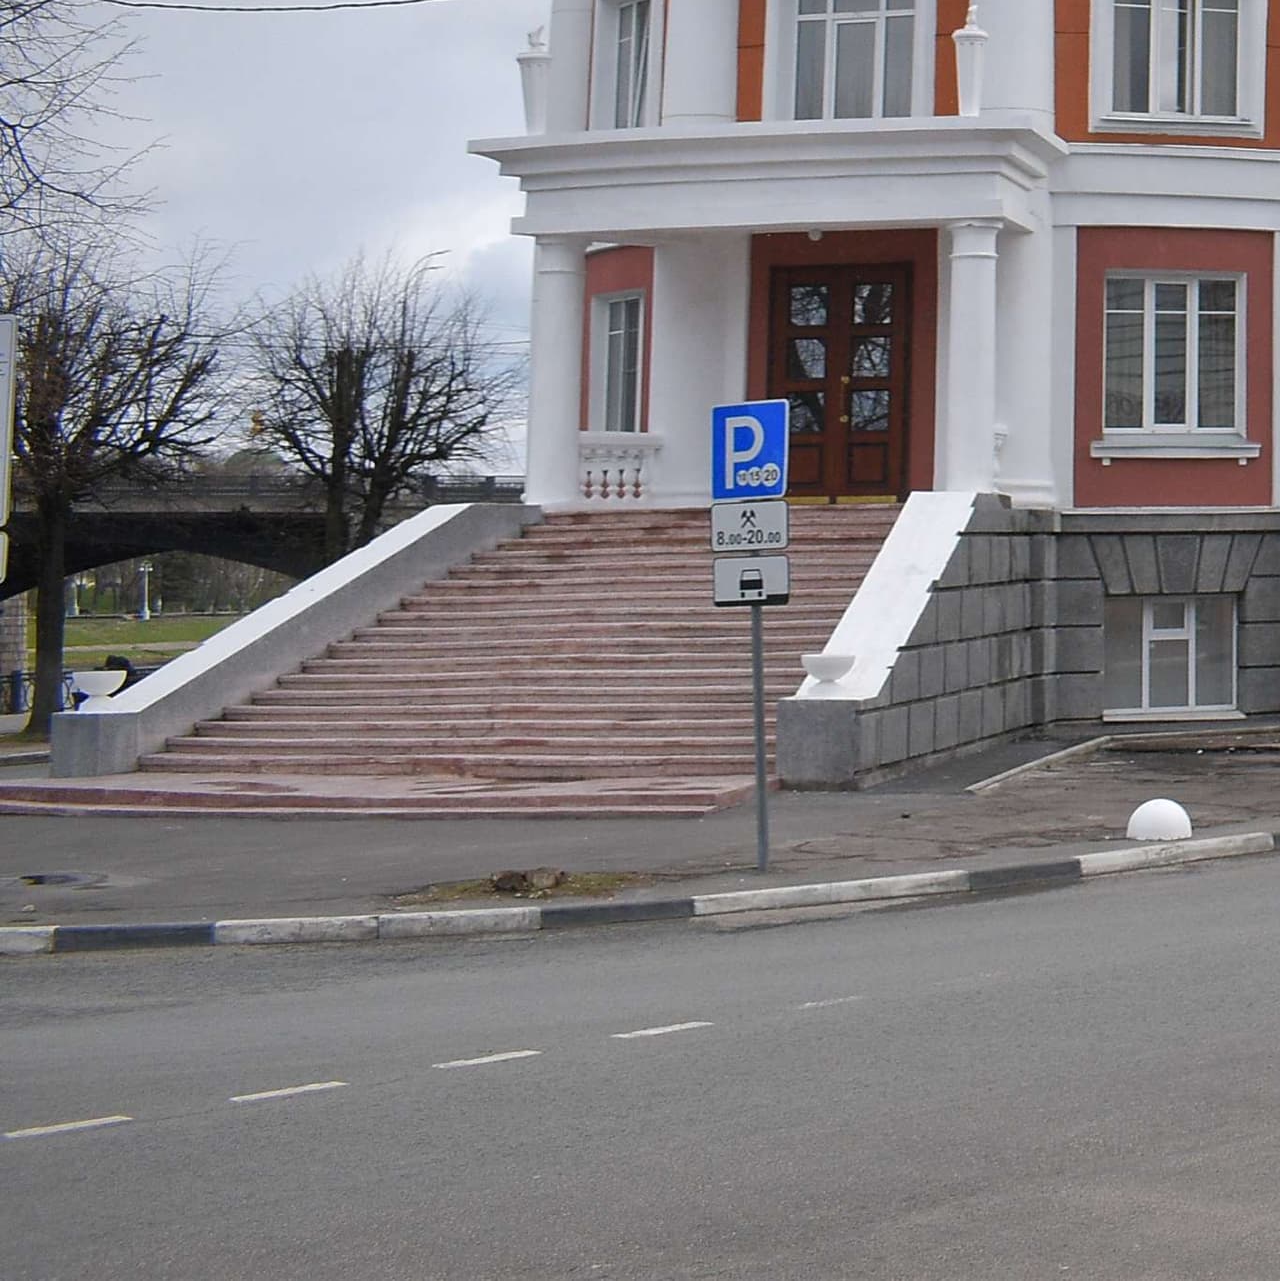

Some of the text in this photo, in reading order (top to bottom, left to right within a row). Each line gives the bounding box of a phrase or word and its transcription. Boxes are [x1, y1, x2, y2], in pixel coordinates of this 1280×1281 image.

[725, 416, 764, 489] P
[750, 470, 760, 481] 15
[764, 469, 778, 481] 20
[716, 529, 782, 546] 8.00-20.00
